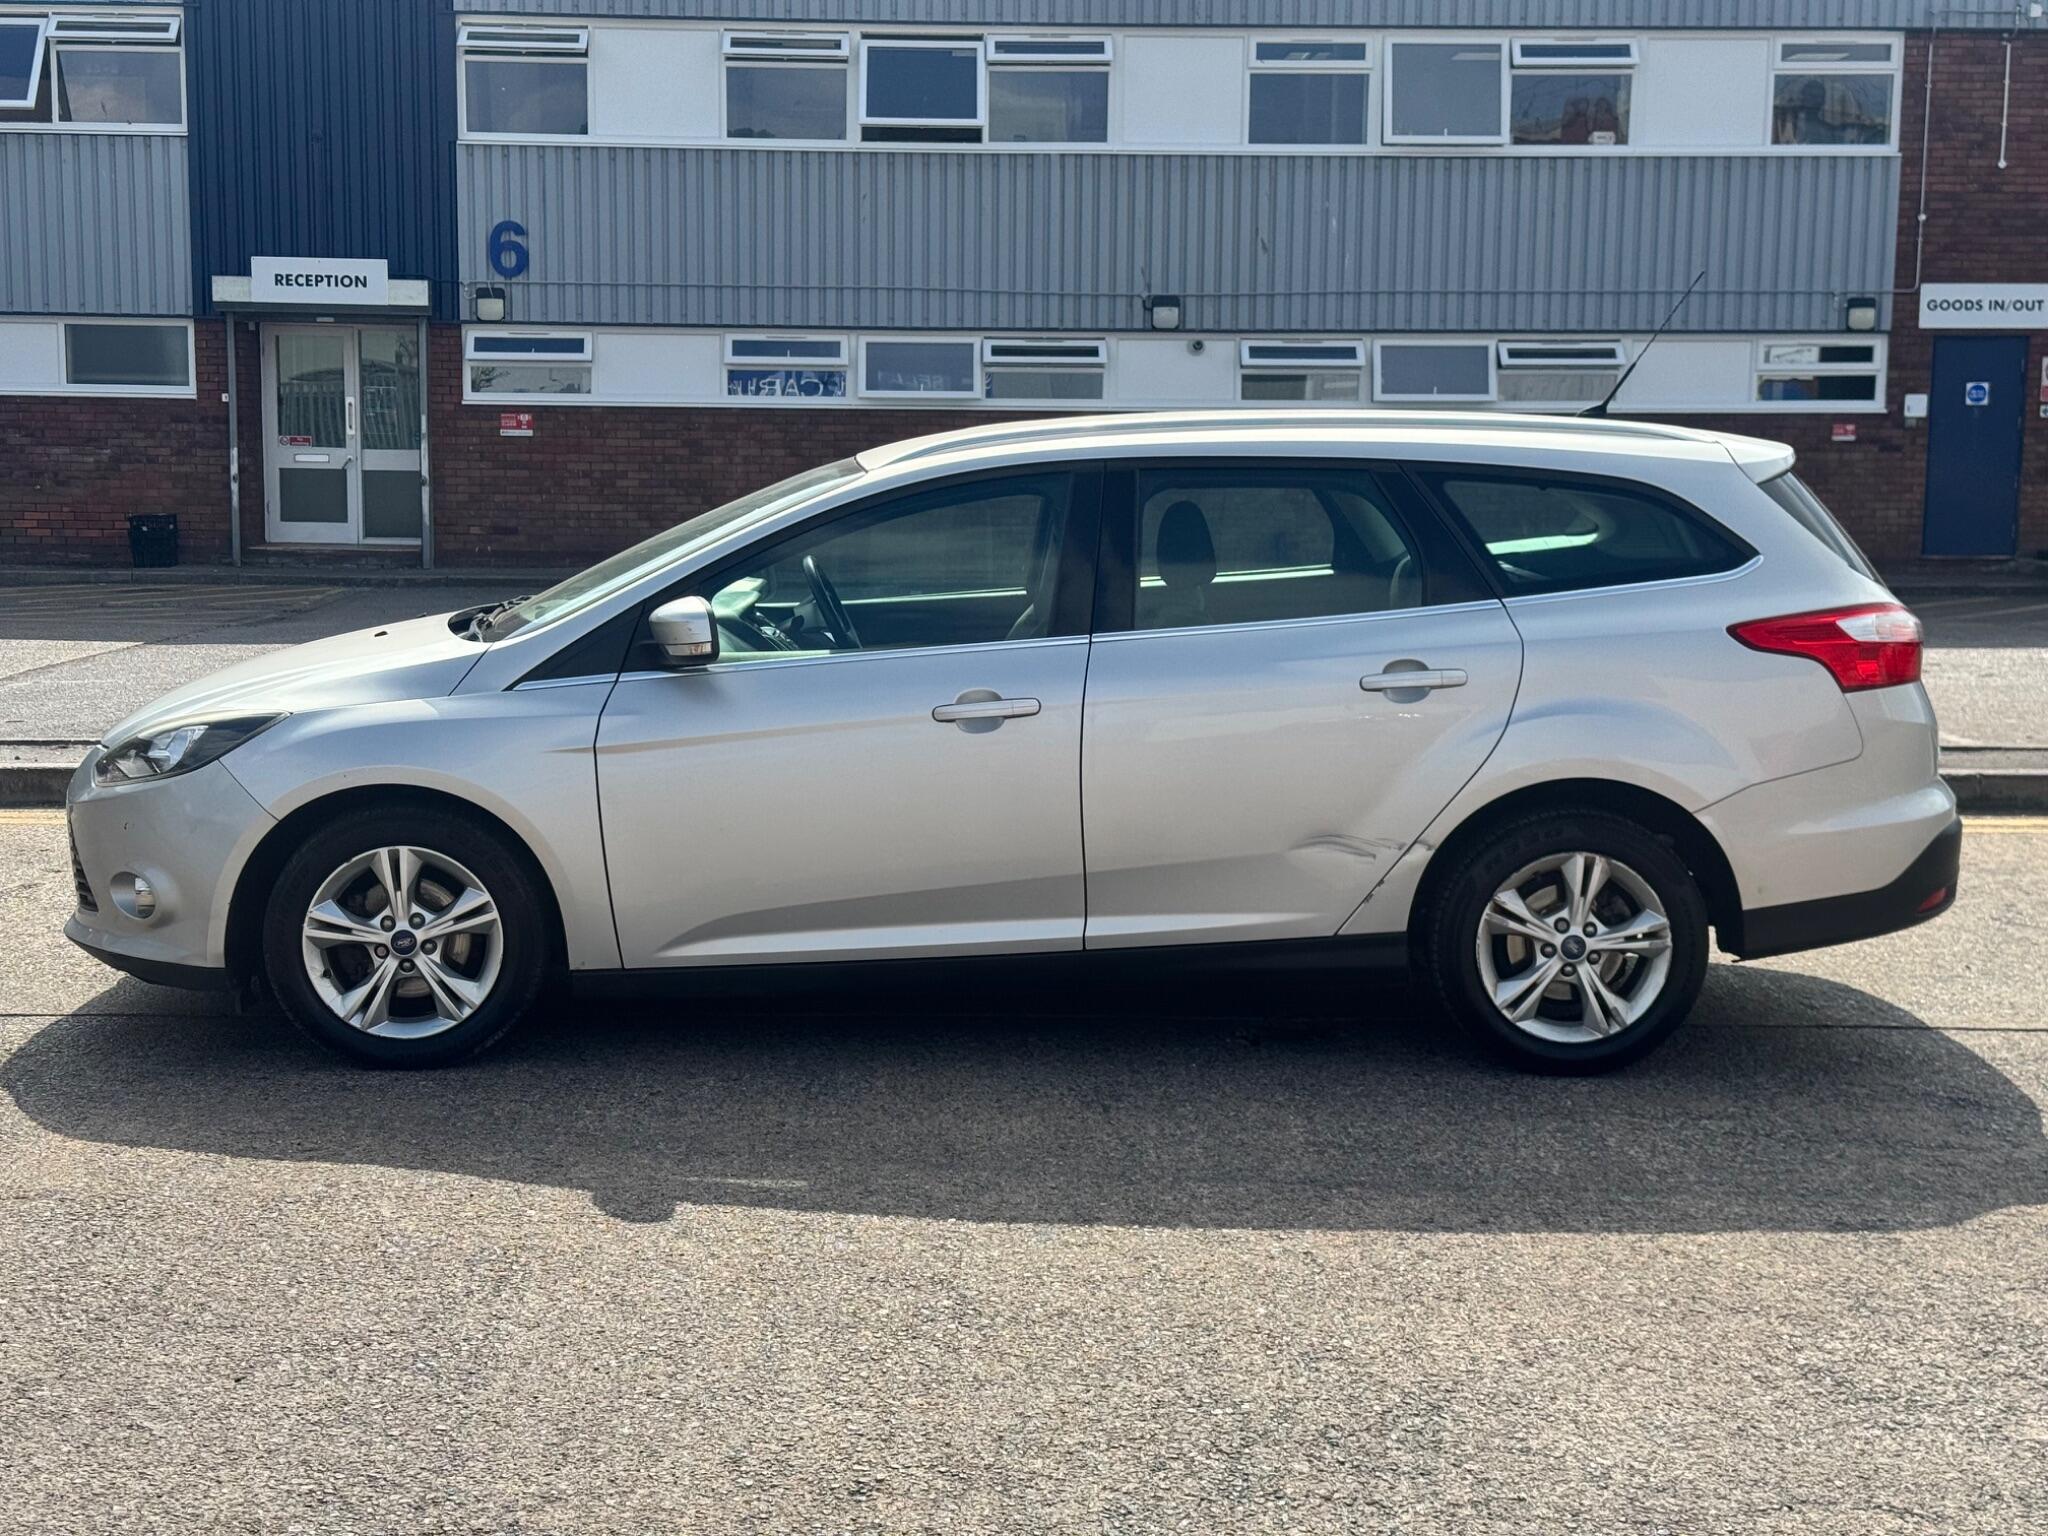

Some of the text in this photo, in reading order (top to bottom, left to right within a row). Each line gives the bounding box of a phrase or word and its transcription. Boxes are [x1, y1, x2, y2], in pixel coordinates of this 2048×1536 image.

[490, 220, 529, 278] 6
[274, 273, 368, 288] RECEPTION
[1926, 299, 2045, 312] GOODS IN/OUT
